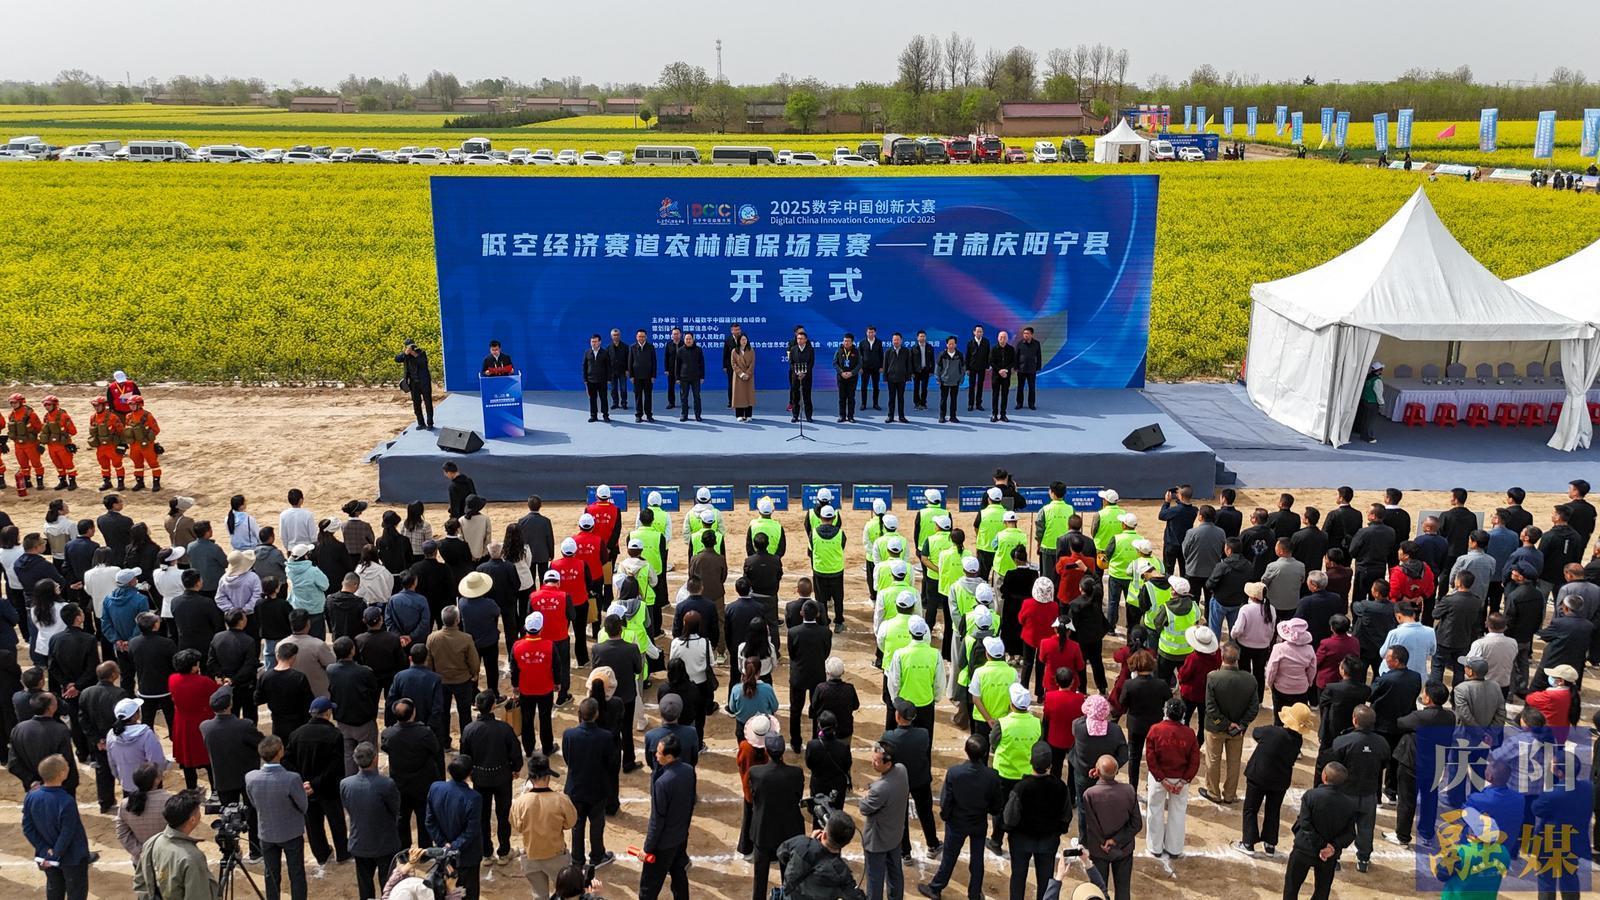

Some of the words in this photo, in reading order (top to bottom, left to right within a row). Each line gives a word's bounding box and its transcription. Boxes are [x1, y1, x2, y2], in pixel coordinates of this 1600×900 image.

[770, 199, 936, 215] 2025数字中国创新大赛
[770, 216, 796, 226] Digital
[796, 216, 819, 224] China
[820, 216, 862, 224] Innovation
[863, 216, 896, 225] Contest,
[896, 216, 916, 224] DCIC
[916, 216, 936, 224] 2025
[480, 231, 1110, 258] 低空经济赛道农林植保场景赛——甘肃庆阳宁县
[729, 267, 863, 304] 开幕式
